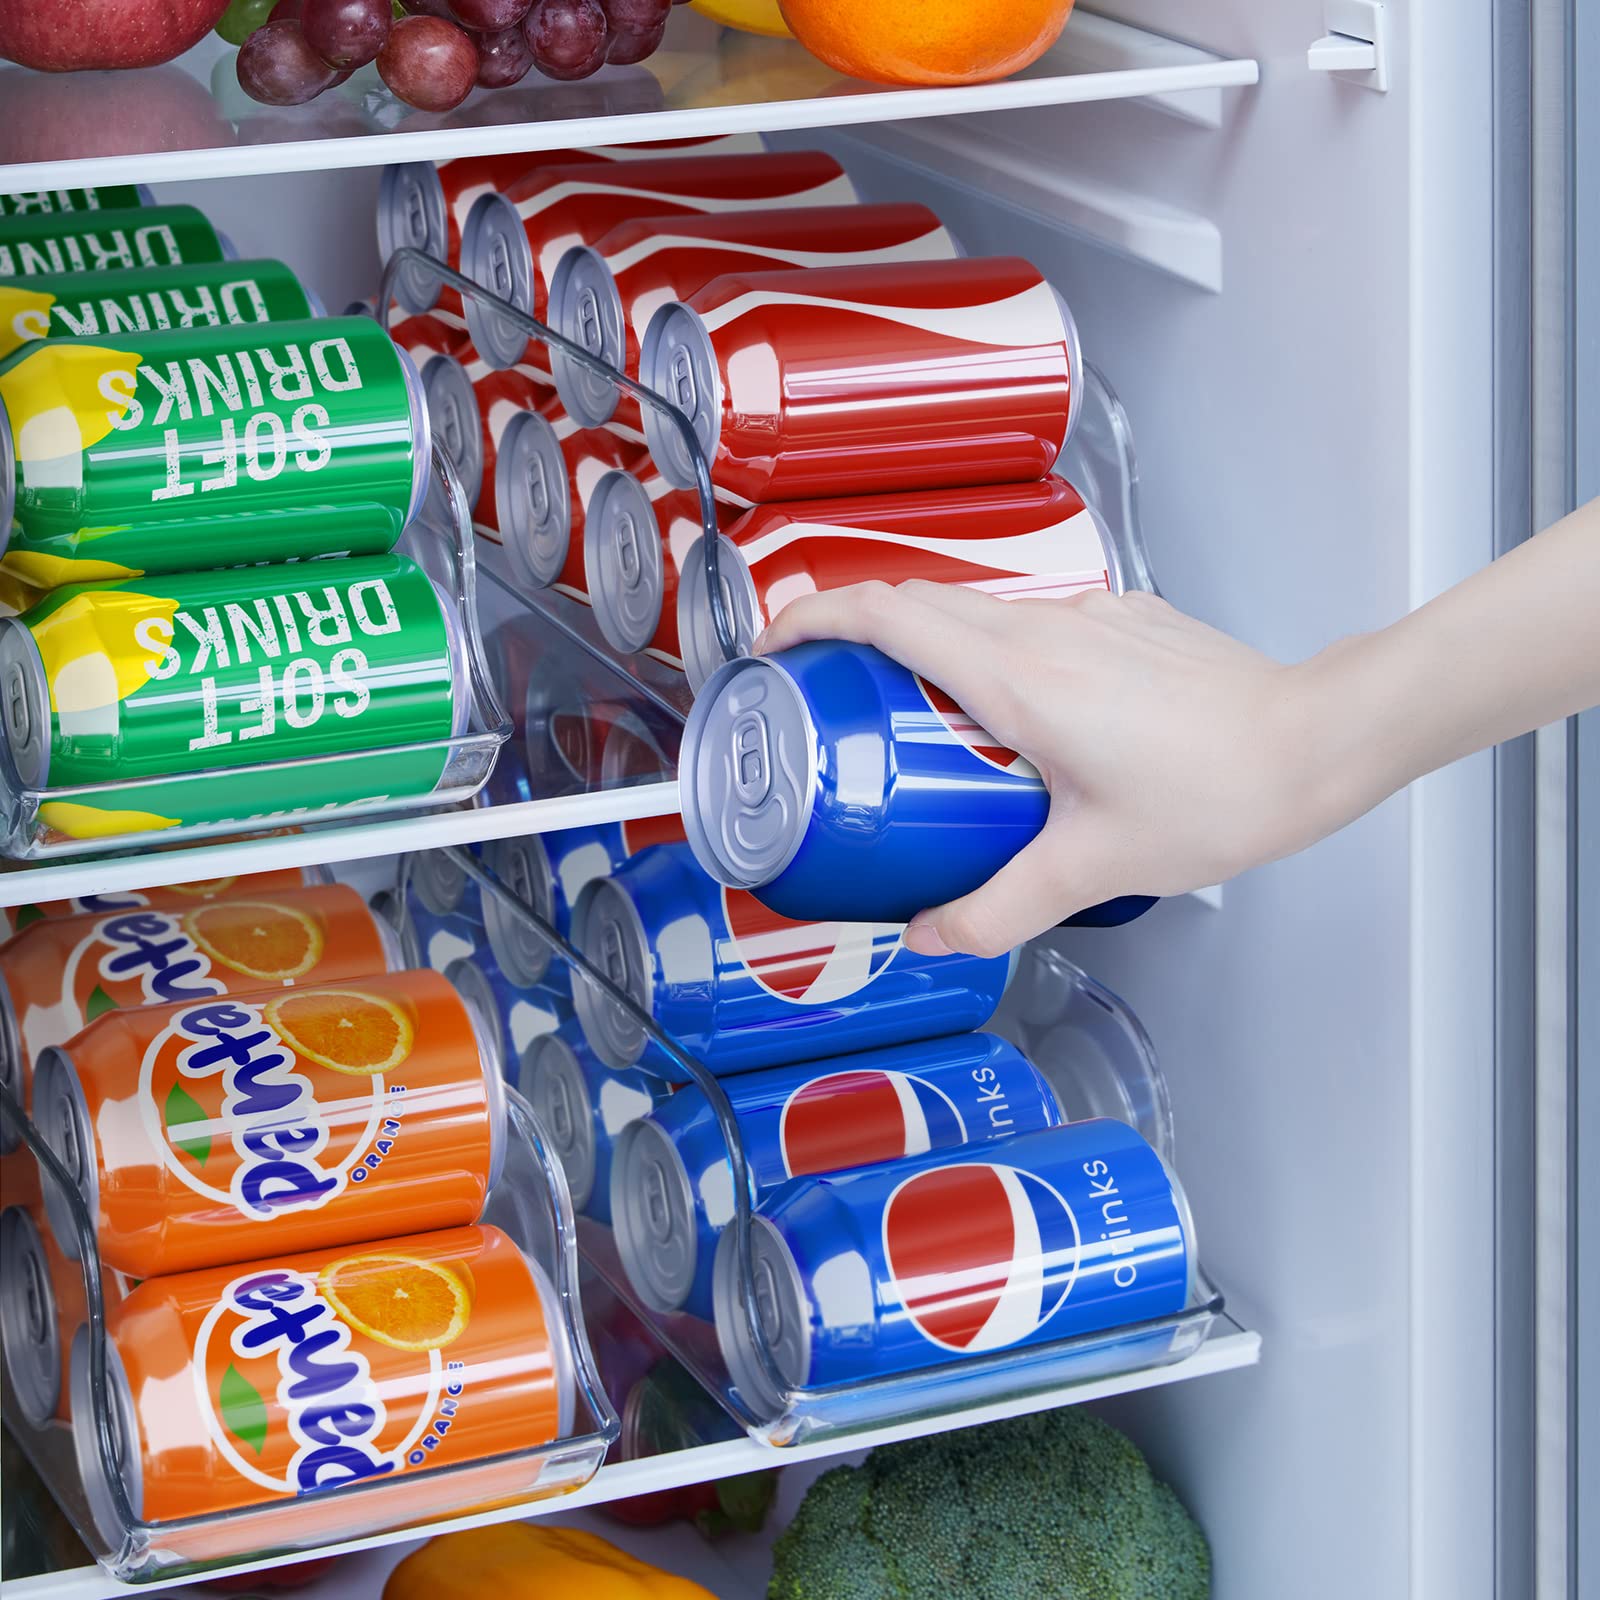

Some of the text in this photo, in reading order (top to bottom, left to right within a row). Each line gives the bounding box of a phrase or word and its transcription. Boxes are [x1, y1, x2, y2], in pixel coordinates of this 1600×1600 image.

[0, 225, 183, 276] DRIN
[98, 338, 362, 430] DRINKS
[152, 403, 332, 501] SOFT
[134, 579, 401, 680] DRINKS
[189, 648, 370, 751] SOFT
[350, 1085, 406, 1183] ORANGE
[972, 1067, 1016, 1140] inks
[408, 1361, 464, 1464] ORANGE
